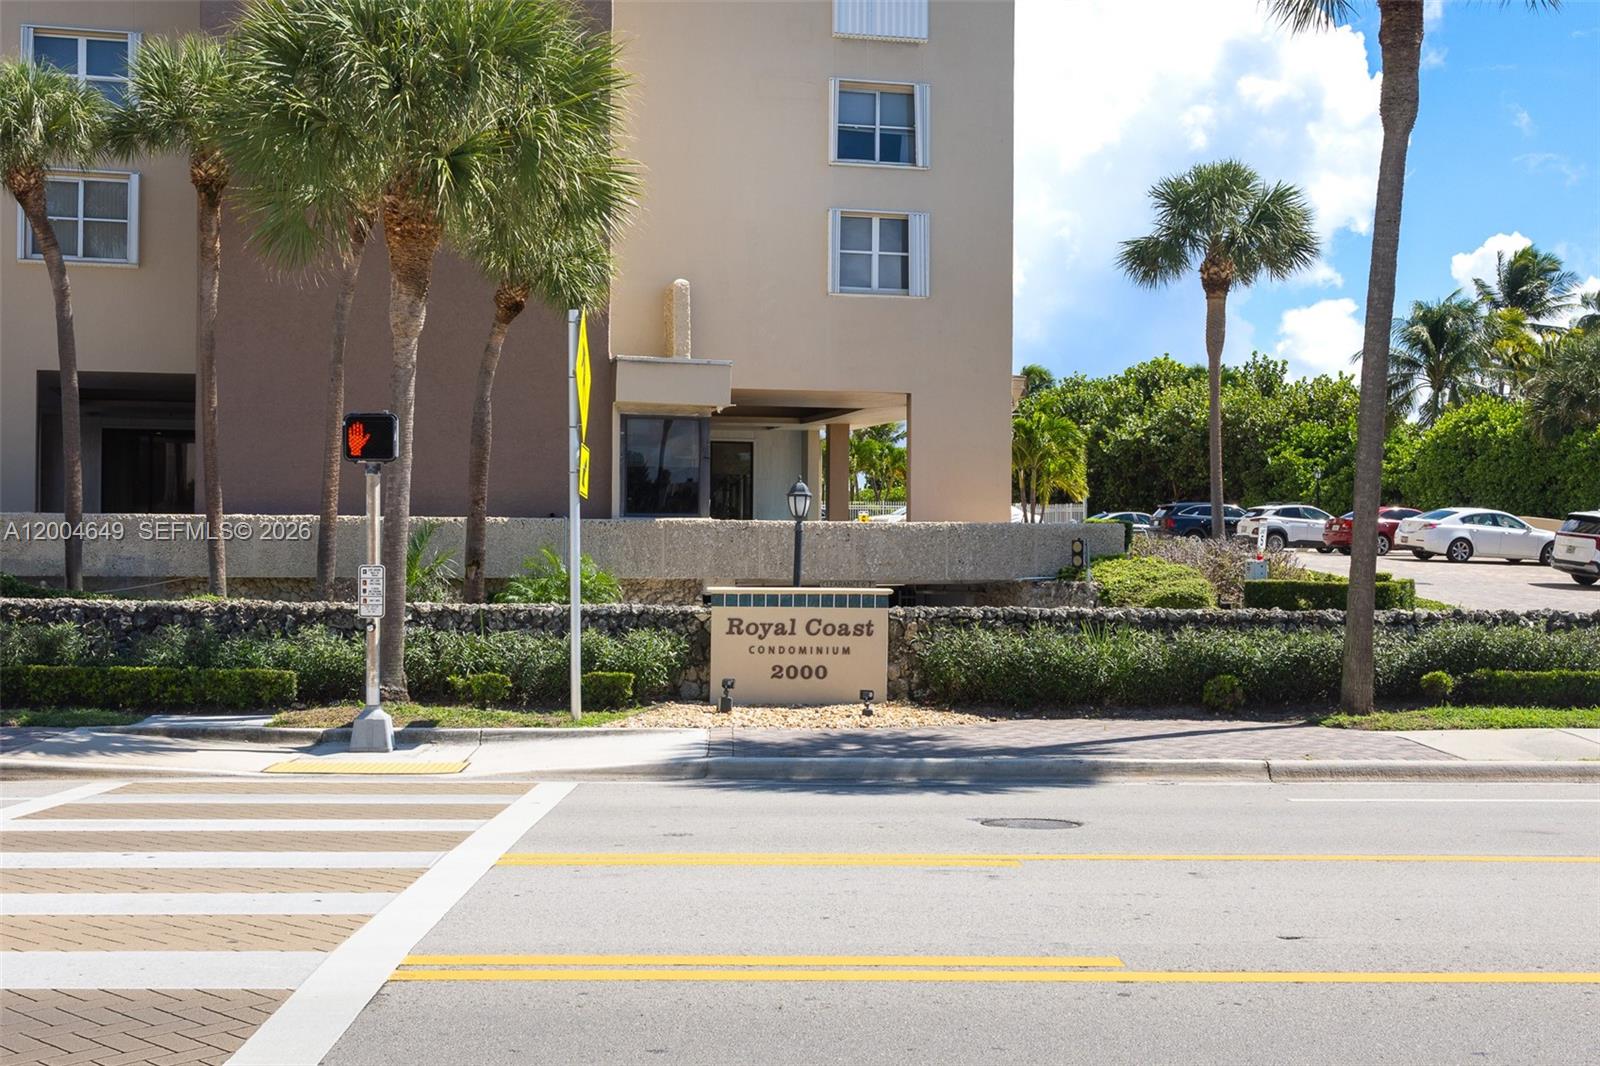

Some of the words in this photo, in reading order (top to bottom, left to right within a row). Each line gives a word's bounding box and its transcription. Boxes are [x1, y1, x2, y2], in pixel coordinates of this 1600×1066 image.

[726, 617, 796, 640] Royal
[805, 618, 874, 637] Coast
[748, 645, 851, 656] CONDOMINIUM
[770, 664, 828, 680] 2000
